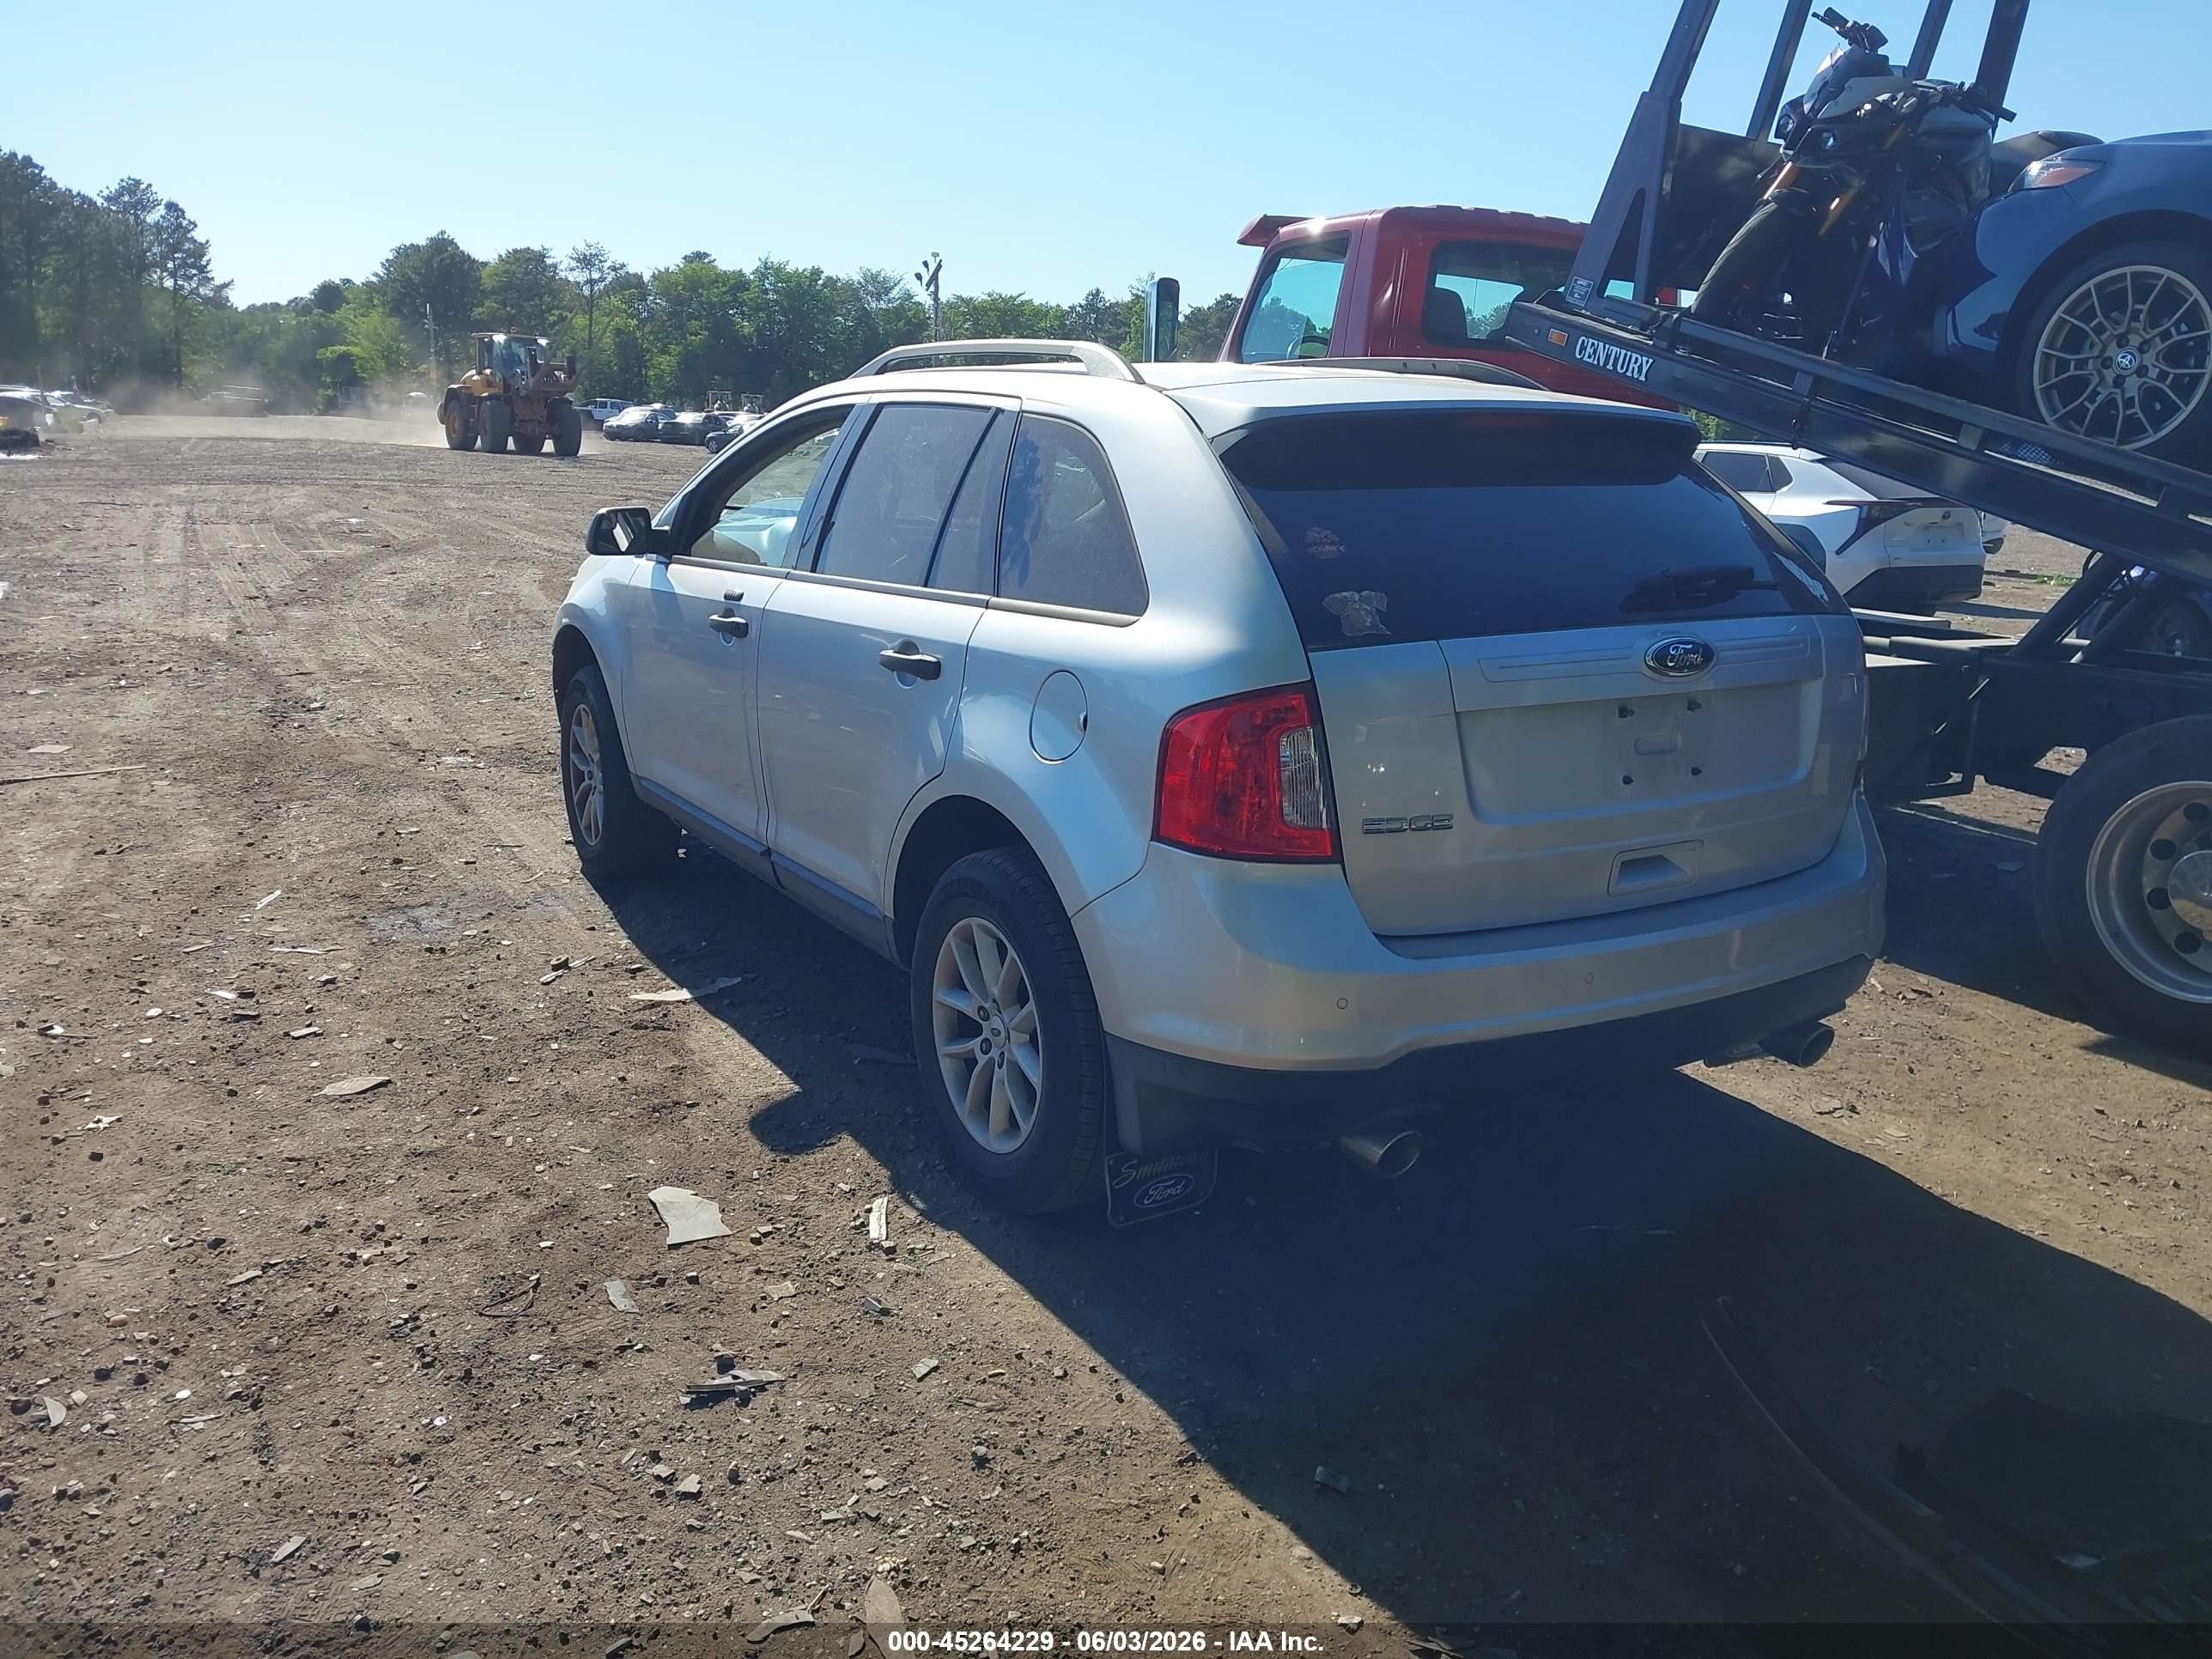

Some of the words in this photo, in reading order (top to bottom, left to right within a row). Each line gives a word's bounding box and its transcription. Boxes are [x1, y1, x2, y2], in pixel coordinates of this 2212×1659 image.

[1575, 336, 1654, 381] CENTURY
[1362, 814, 1454, 835] EDGE
[1144, 1179, 1187, 1205] Ford
